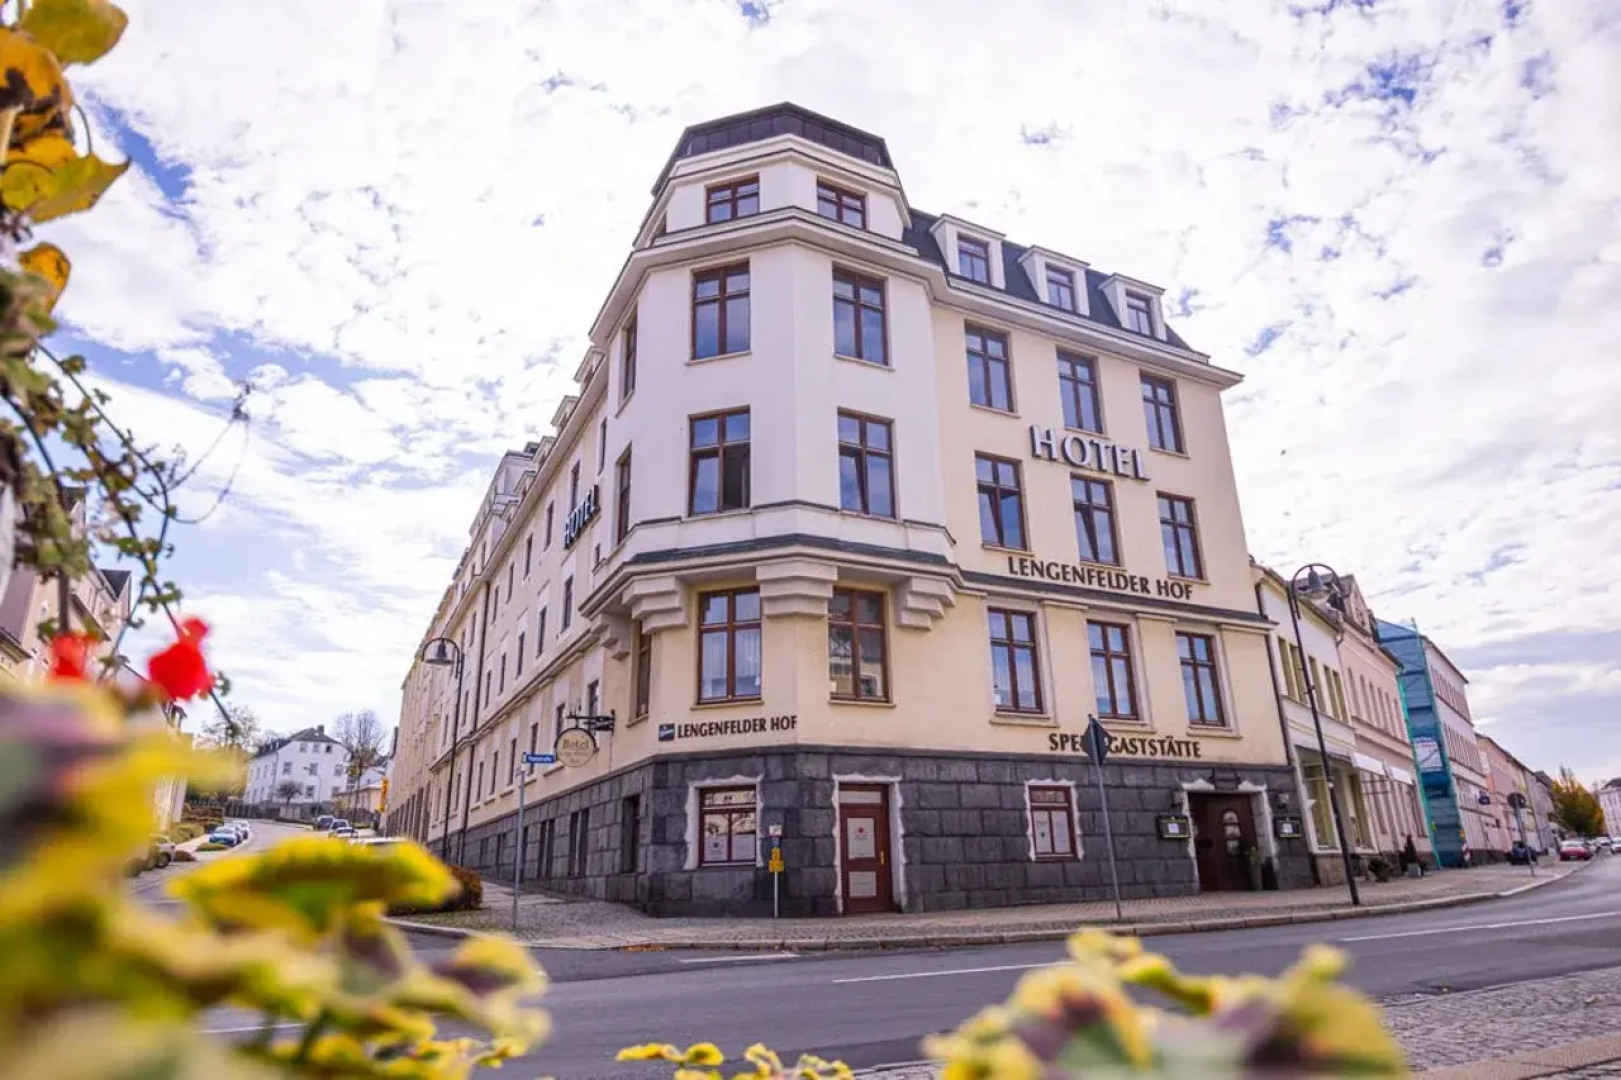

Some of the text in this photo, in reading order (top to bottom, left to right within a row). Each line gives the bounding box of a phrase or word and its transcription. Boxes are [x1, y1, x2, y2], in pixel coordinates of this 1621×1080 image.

[1030, 424, 1150, 482] HOTEL
[564, 484, 601, 550] HOTEL
[1007, 556, 1193, 600] LENGENFELDER HOF
[677, 715, 797, 738] LENGENFELDER HOF
[1049, 733, 1202, 757] SPEGASTSTÄTTE
